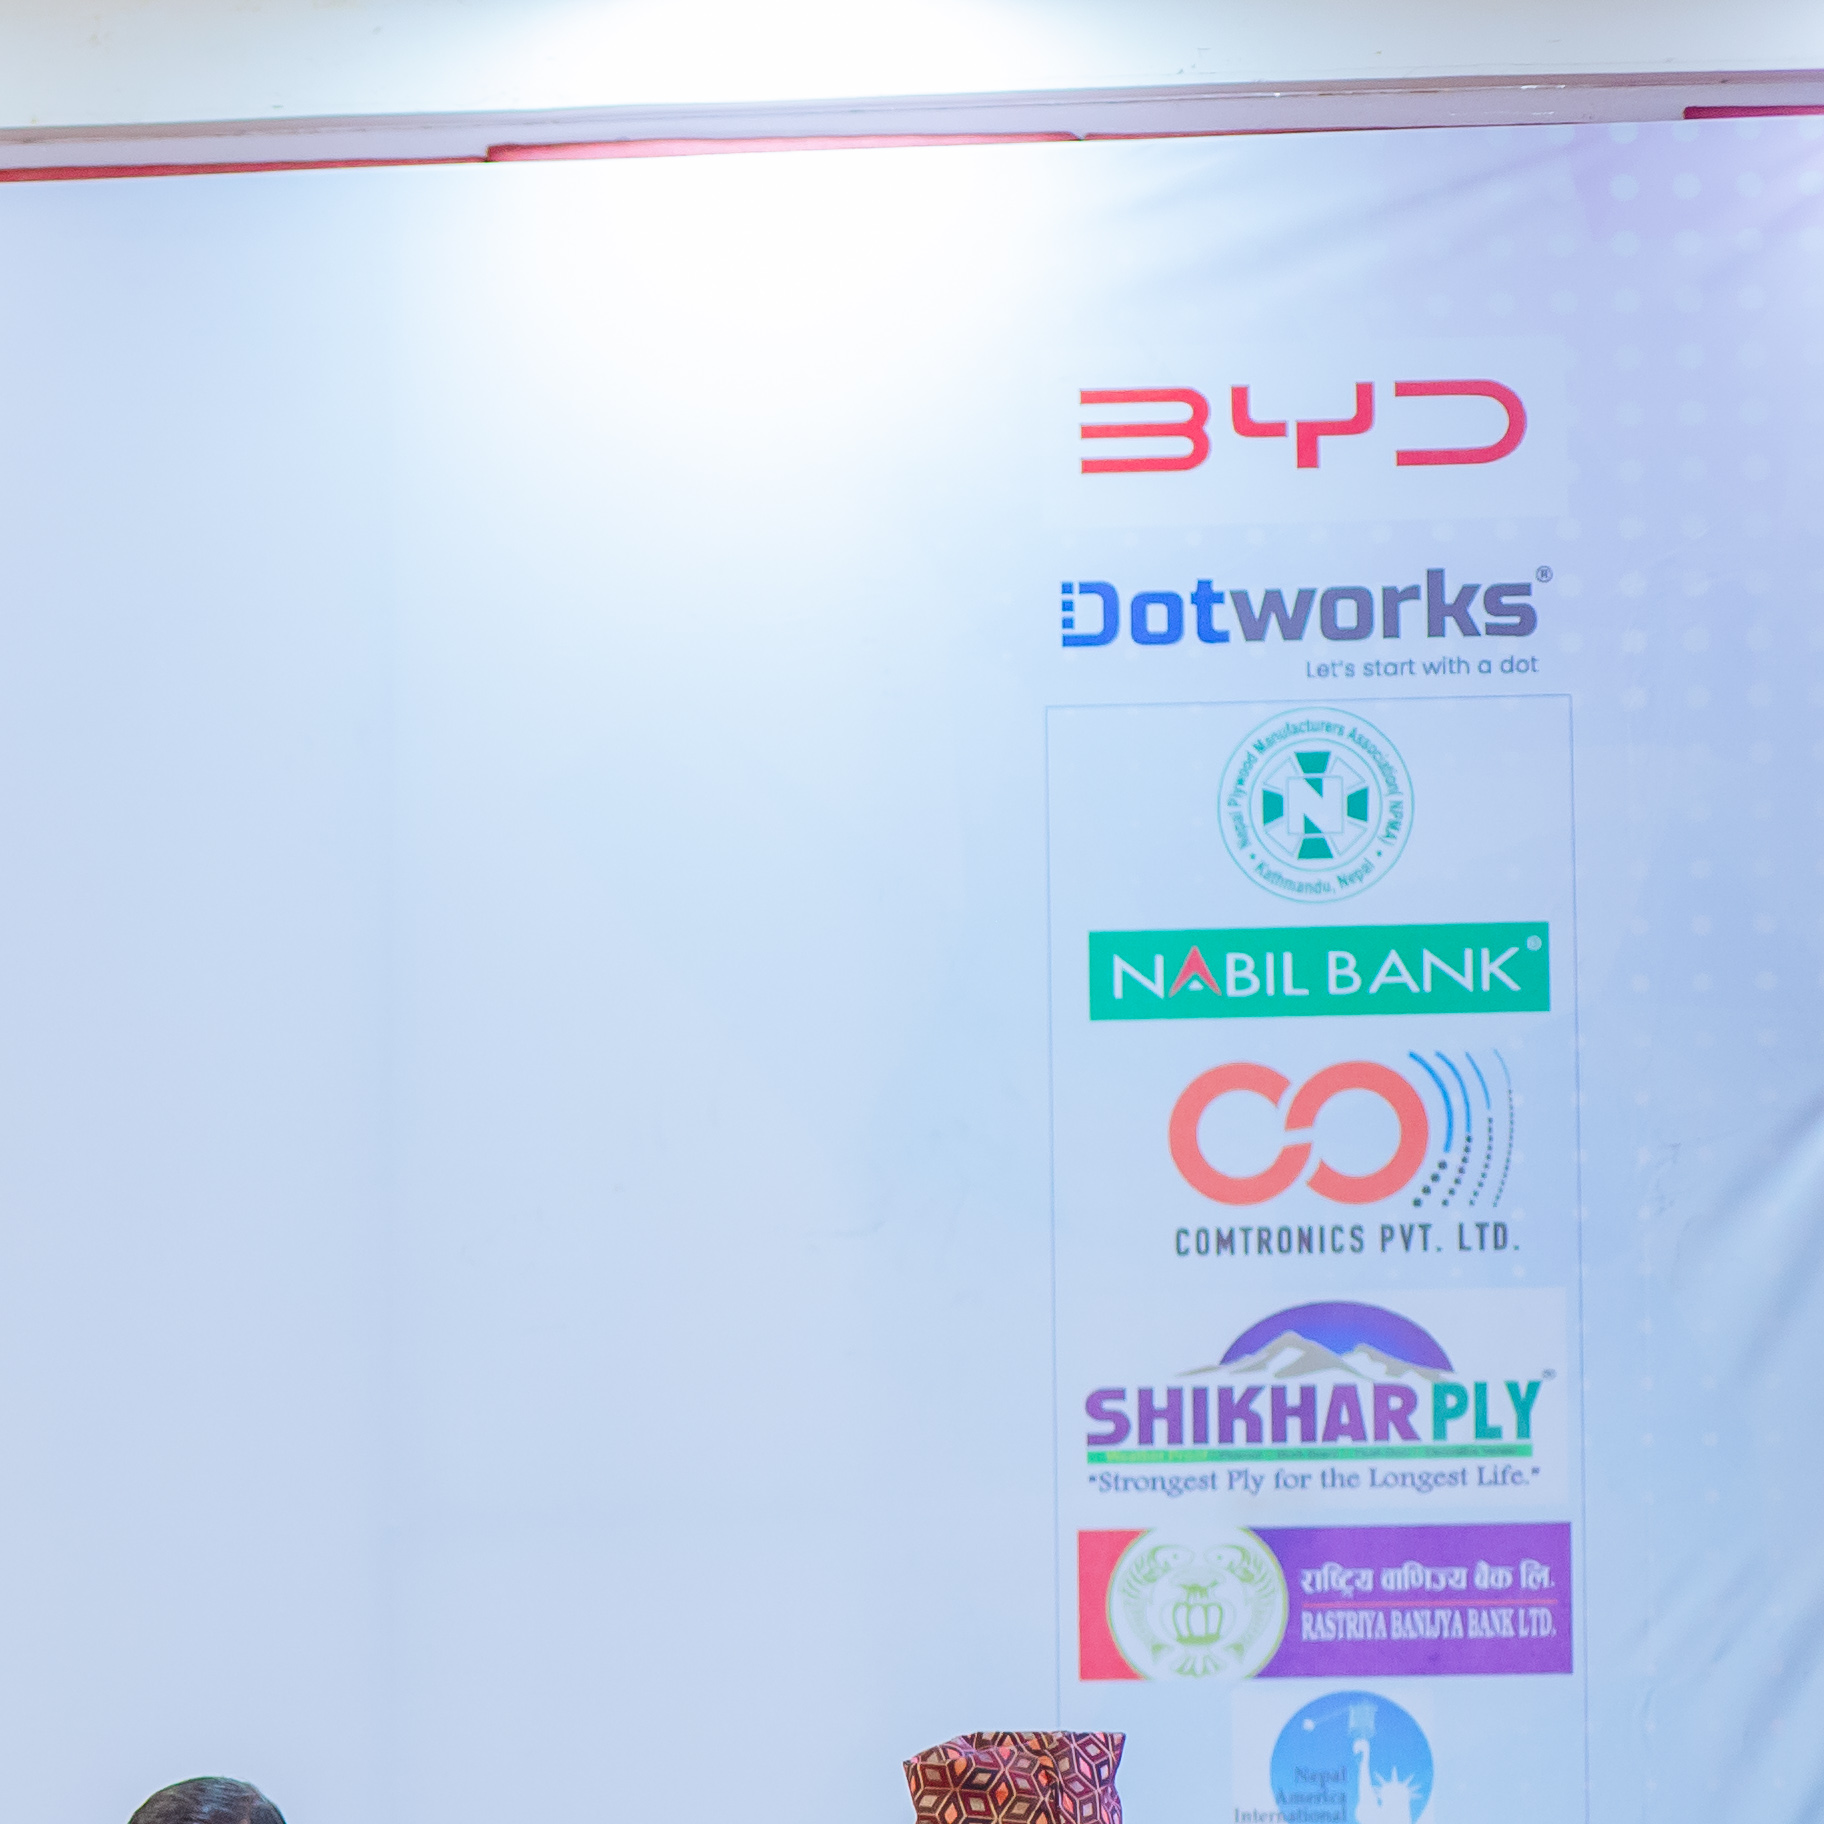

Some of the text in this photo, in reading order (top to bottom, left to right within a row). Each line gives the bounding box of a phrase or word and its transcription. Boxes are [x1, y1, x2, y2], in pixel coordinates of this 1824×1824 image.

[1080, 378, 1527, 474] BYD
[1062, 568, 1538, 648] Dotworks
[1306, 654, 1539, 679] Let's start with a dot
[1252, 718, 1345, 753] Manufacturers
[1113, 945, 1521, 999] NABIL BANK
[1175, 1221, 1520, 1257] COMTRONICS PVT. LTD.
[1227, 1468, 1265, 1500] Ply
[1274, 1466, 1312, 1492] for
[1320, 1465, 1356, 1490] the
[1369, 1464, 1468, 1496] Longest
[1302, 1608, 1387, 1642] RASTRIYA
[1467, 1607, 1515, 1640] BANK
[1294, 1766, 1347, 1787] Nepal
[1234, 1807, 1347, 1824] International
